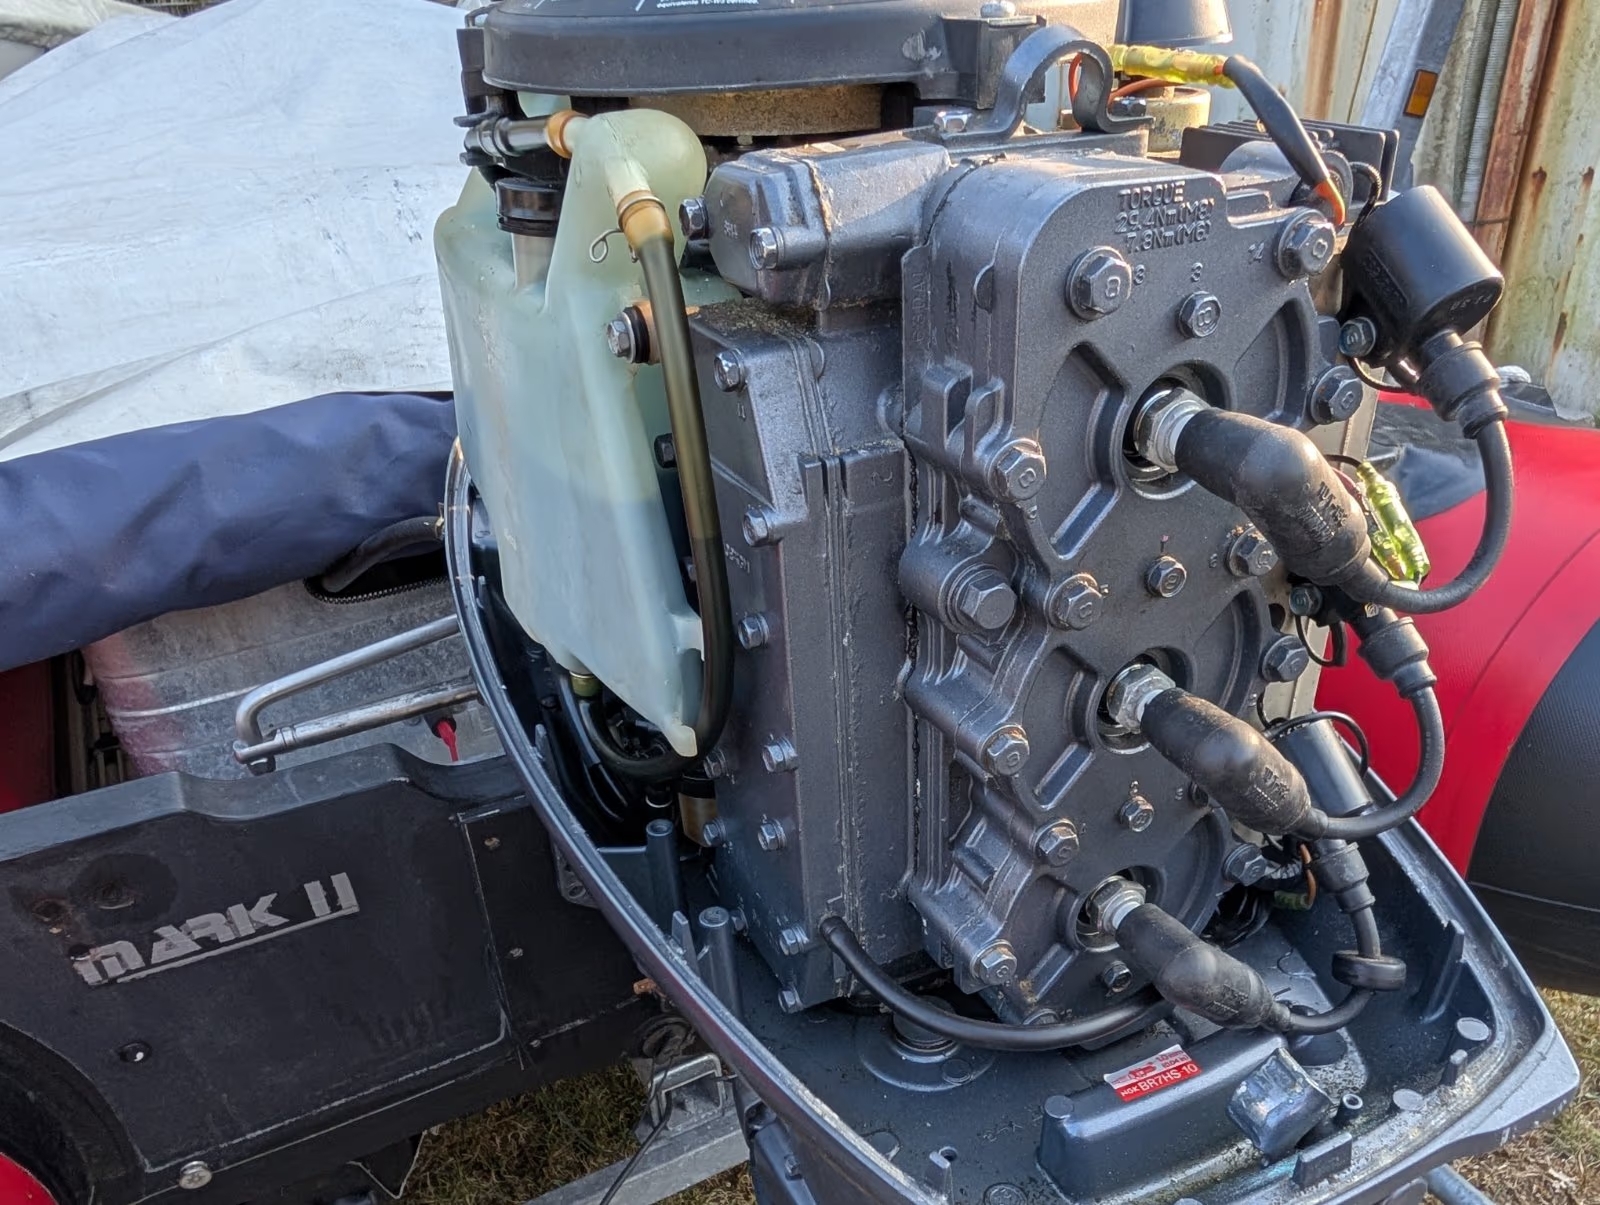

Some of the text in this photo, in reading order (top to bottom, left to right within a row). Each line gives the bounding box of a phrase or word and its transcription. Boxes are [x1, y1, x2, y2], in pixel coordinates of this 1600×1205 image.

[1118, 181, 1185, 211] TORQUE
[73, 872, 359, 986] MARK II
[1120, 1063, 1198, 1097] NGK BR7HS-10
